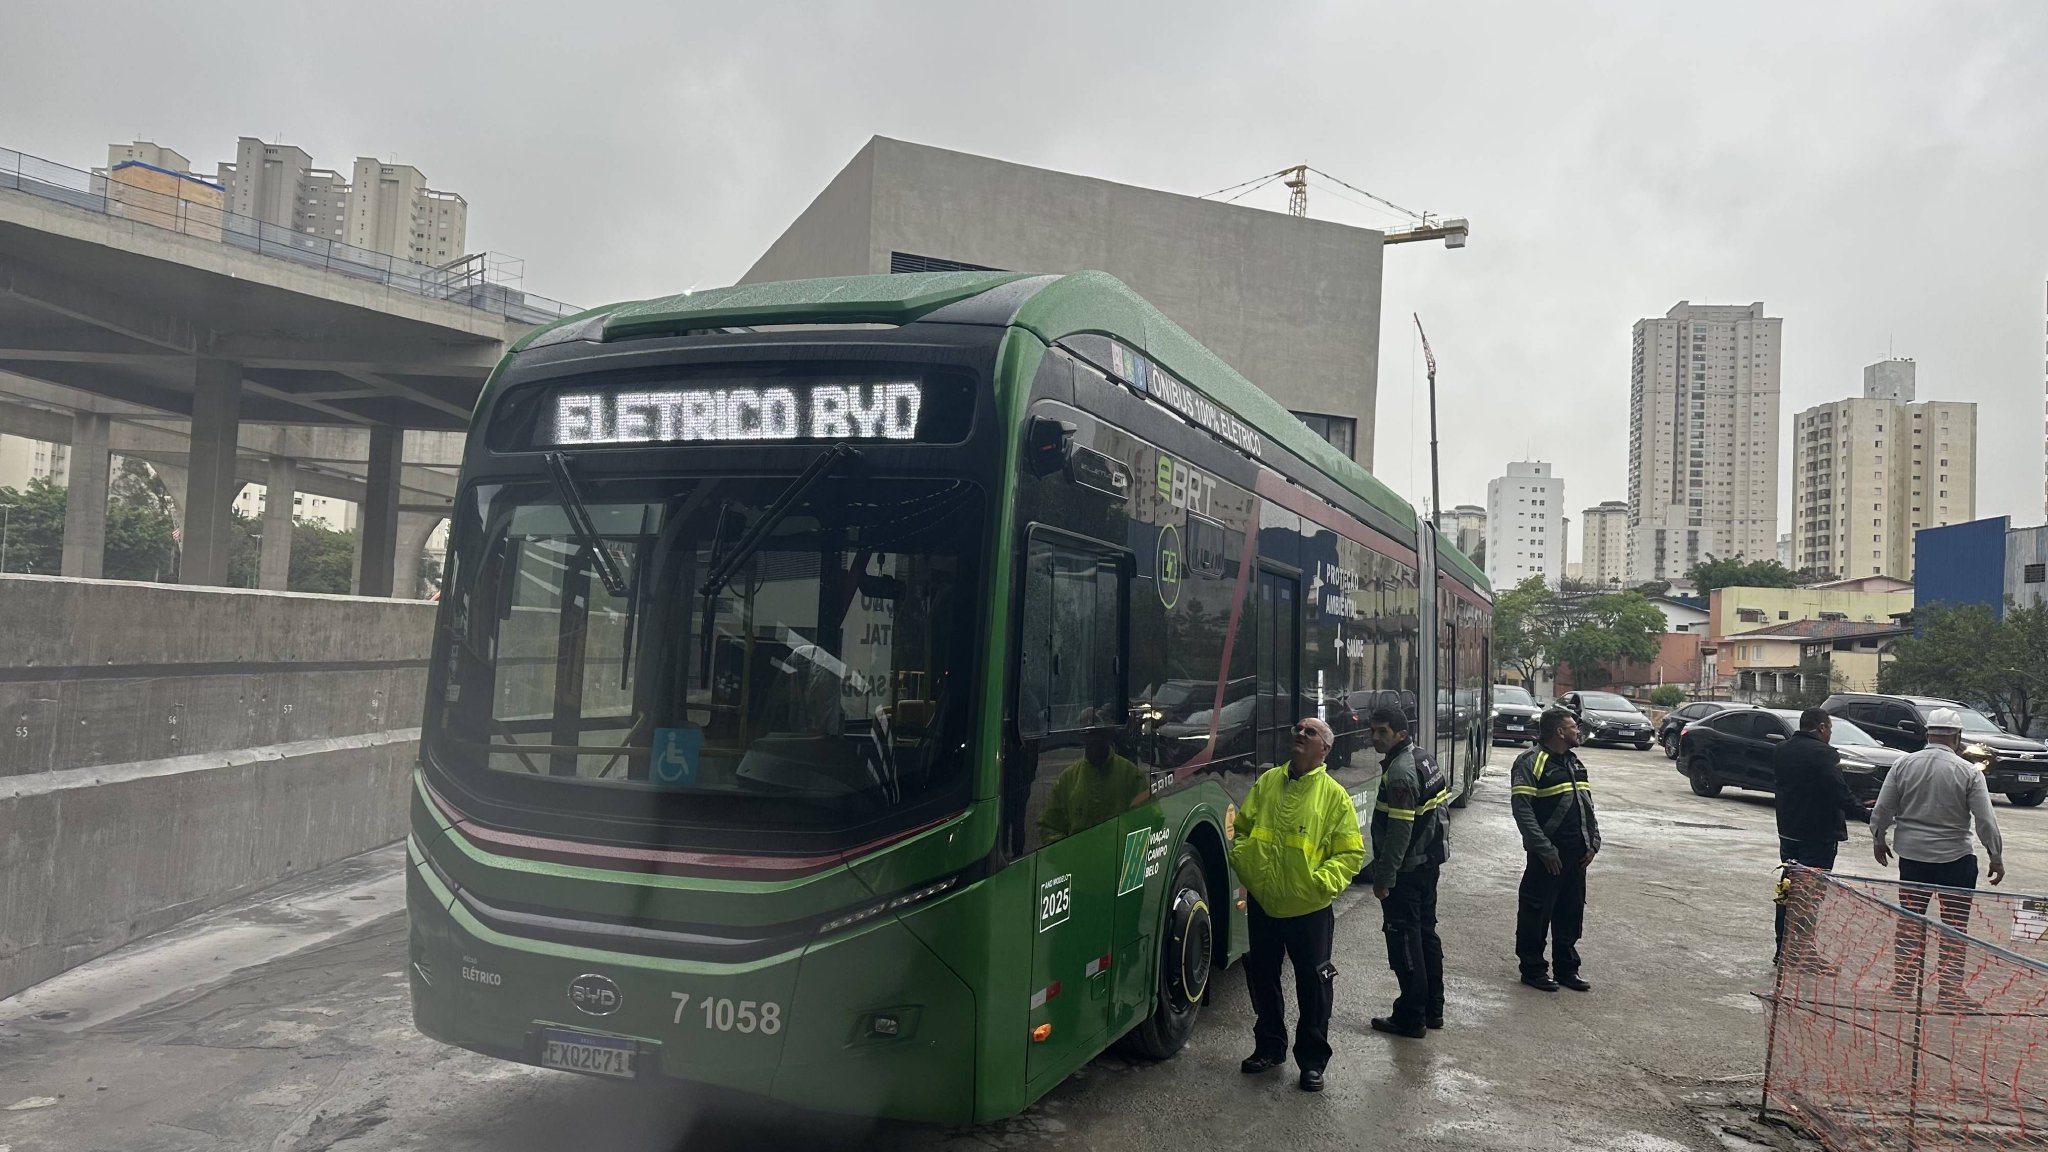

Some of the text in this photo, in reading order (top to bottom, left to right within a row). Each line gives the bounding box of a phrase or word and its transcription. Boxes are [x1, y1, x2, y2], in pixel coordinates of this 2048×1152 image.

[558, 387, 798, 445] ELETRICO
[1152, 363, 1262, 457] ÔNIBUS 100% ELÉTRICO
[1326, 563, 1359, 591] PROTEÇÃO
[1325, 594, 1358, 618] AMBIENTAL
[1346, 635, 1364, 658] SAÚDE
[1151, 773, 1174, 794] CAIO
[1149, 828, 1170, 845] VIAÇÃO
[1147, 845, 1168, 862] CAMPO
[1145, 862, 1159, 878] BELO
[1042, 887, 1069, 920] 2025
[462, 966, 501, 986] ELÉTRICO
[573, 985, 615, 1006] BYD
[671, 991, 781, 1035] 7 1058
